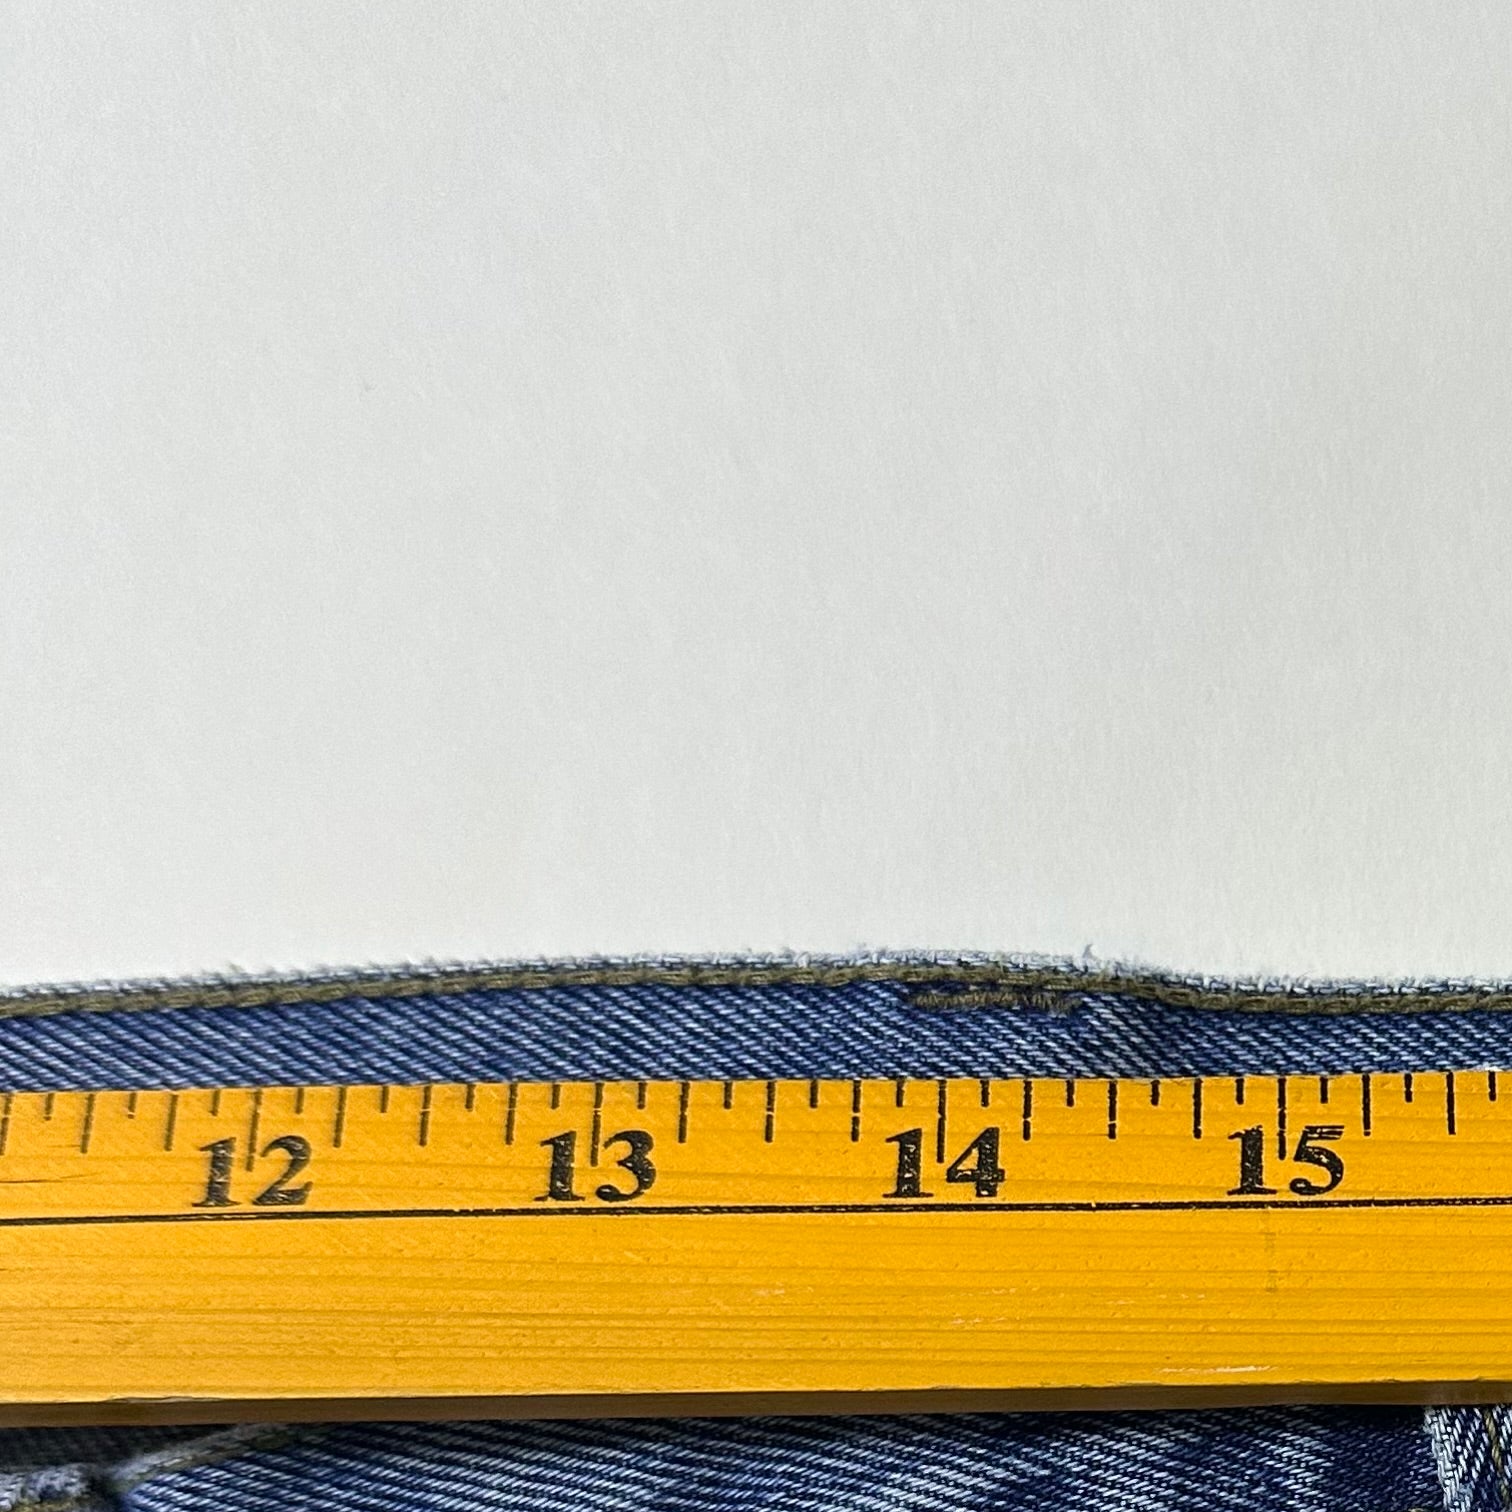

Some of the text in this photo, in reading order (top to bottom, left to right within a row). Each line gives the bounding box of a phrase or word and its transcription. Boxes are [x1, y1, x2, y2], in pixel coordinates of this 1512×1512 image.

[192, 1135, 312, 1207] 12
[535, 1130, 656, 1202] 13
[881, 1127, 1004, 1197] 14
[1226, 1124, 1345, 1194] 15
